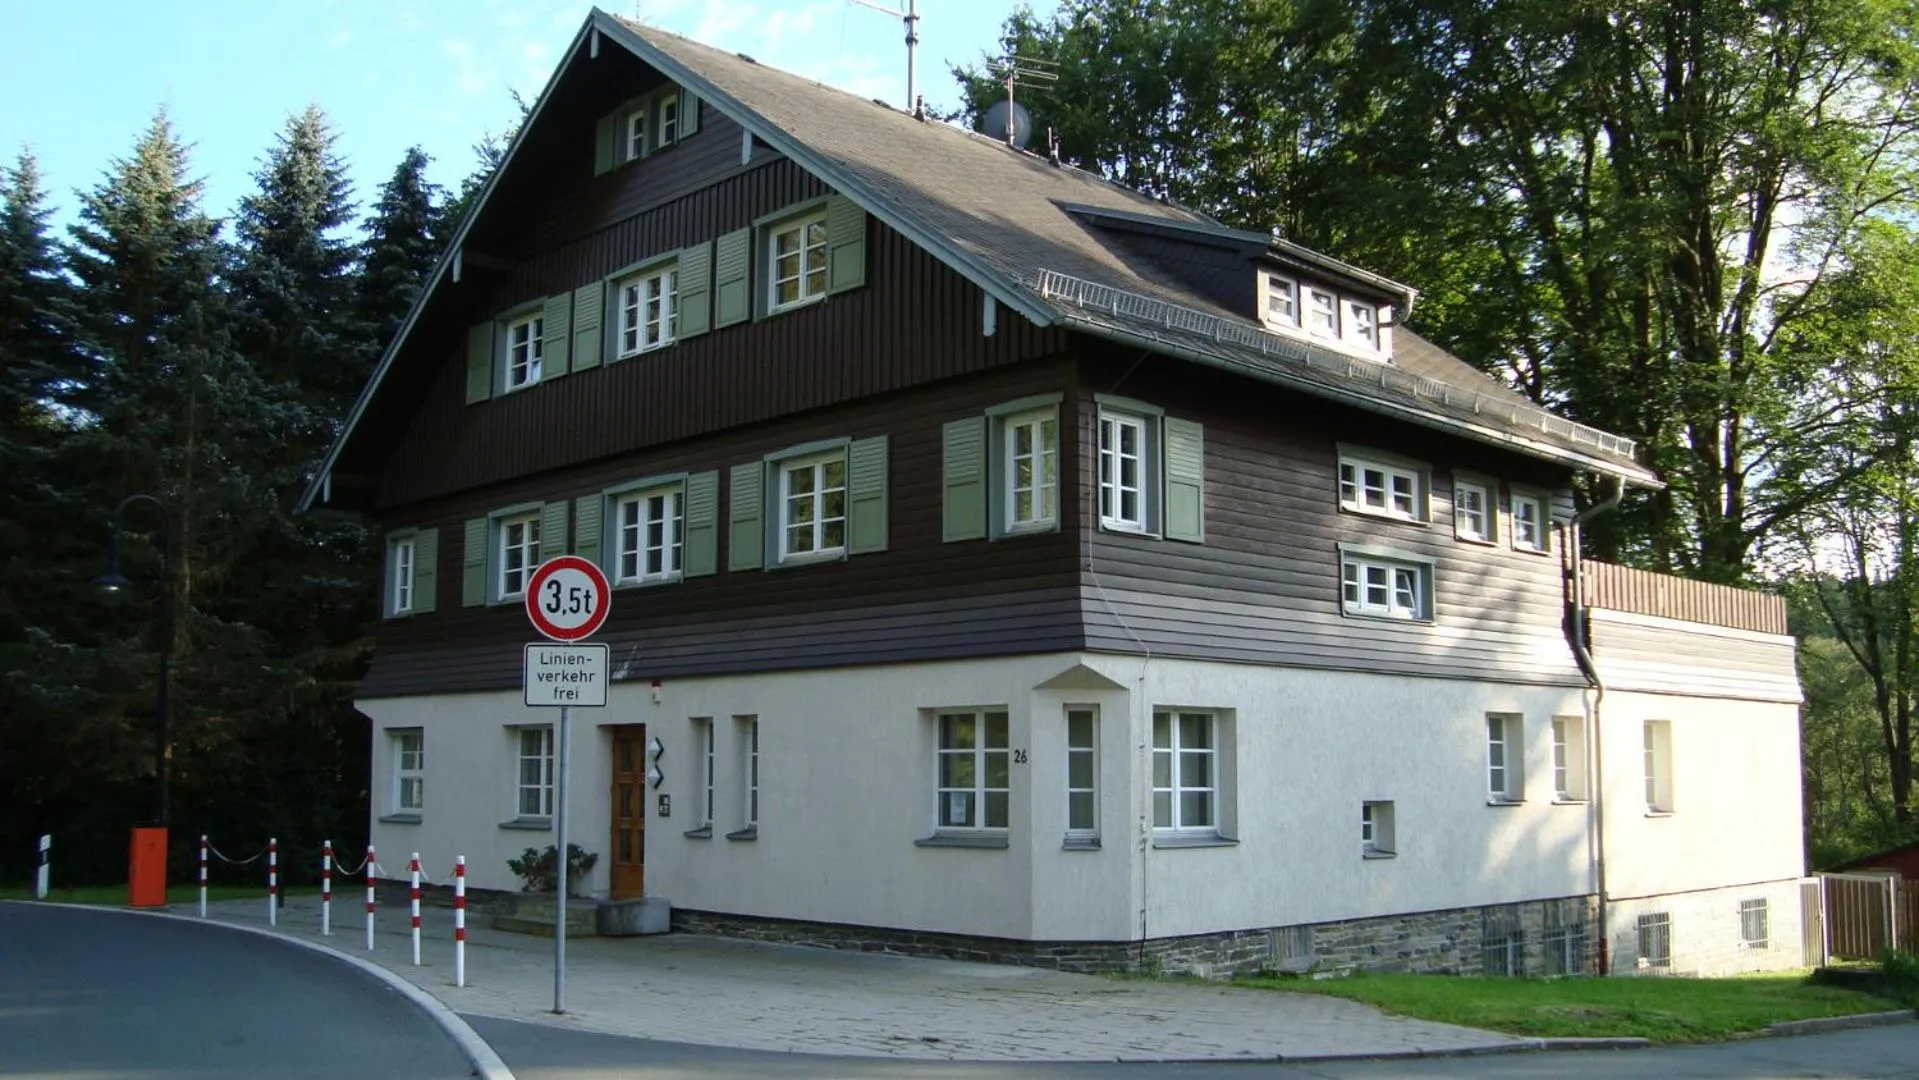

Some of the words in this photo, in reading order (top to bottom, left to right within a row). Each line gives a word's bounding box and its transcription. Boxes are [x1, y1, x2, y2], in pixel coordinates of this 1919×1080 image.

[546, 579, 592, 615] 3,5t
[540, 652, 592, 665] Linien-
[537, 669, 595, 682] verkehr
[554, 686, 579, 700] frei
[1014, 749, 1028, 764] 26
